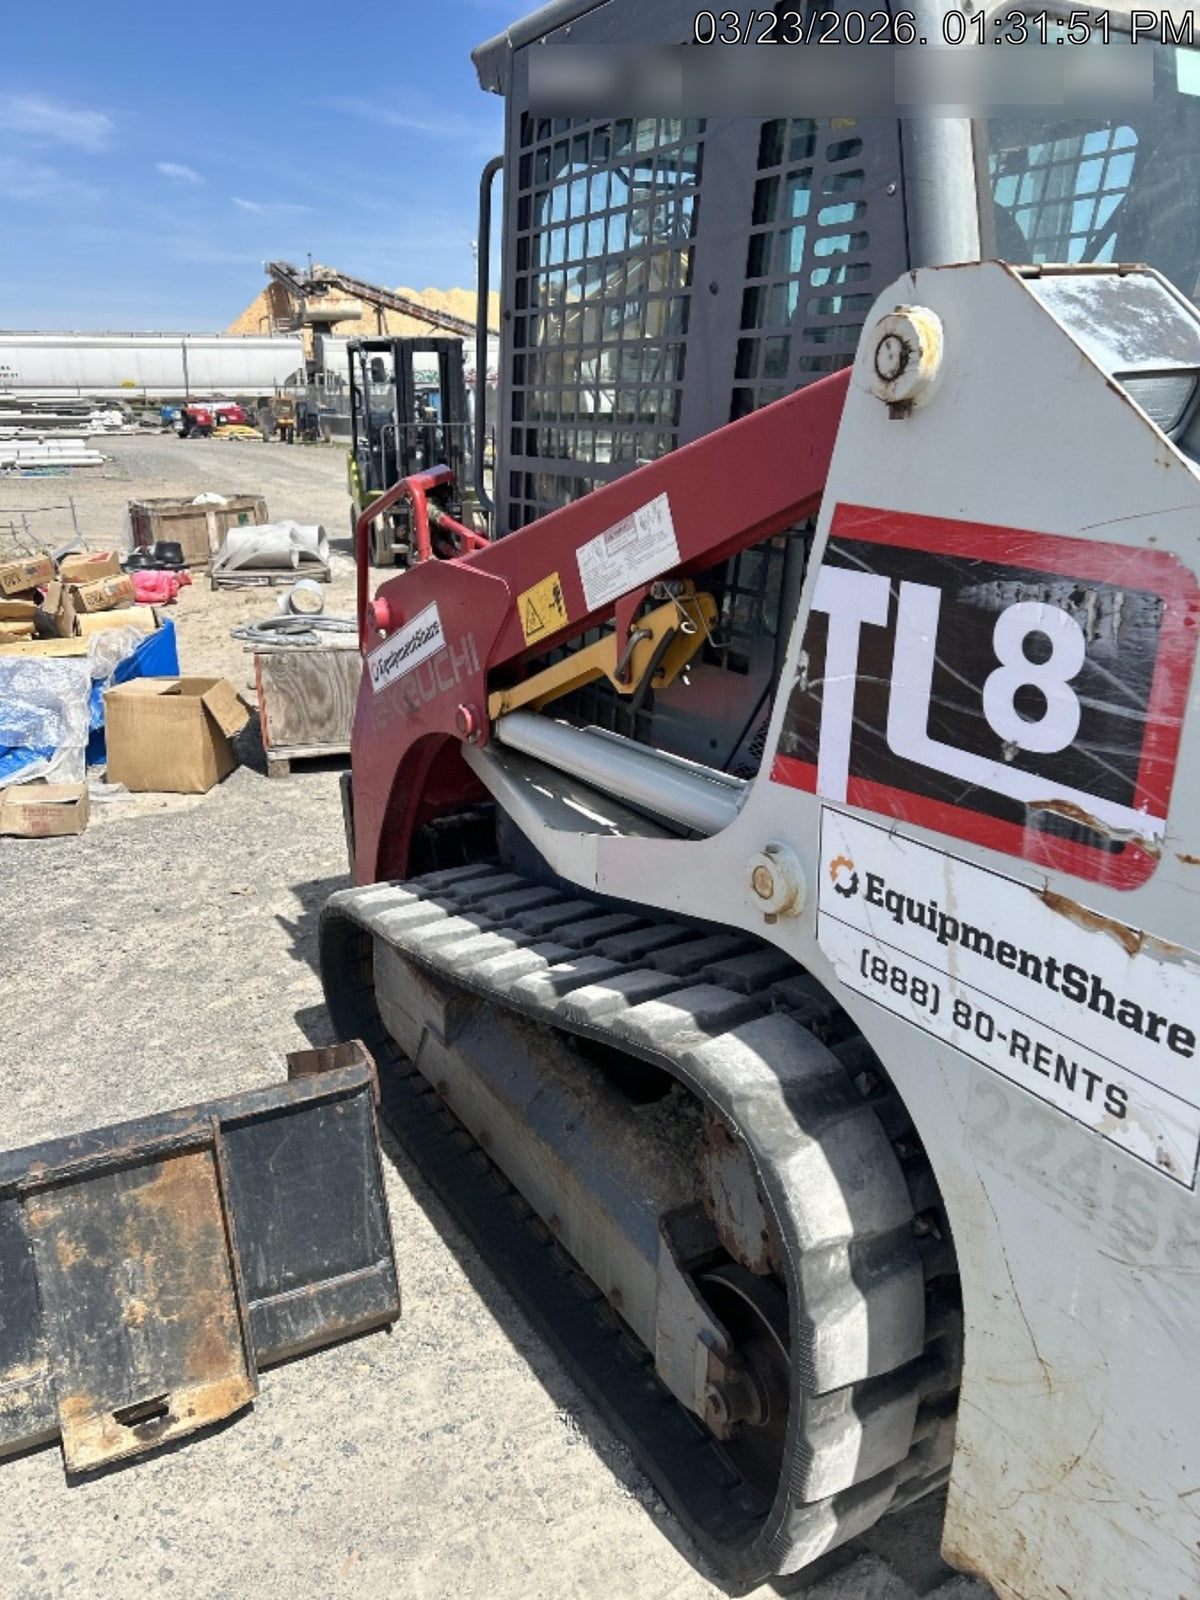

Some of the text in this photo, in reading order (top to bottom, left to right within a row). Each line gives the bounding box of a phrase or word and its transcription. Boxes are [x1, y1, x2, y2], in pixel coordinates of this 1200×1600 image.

[810, 565, 1167, 839] TL8
[860, 949, 1129, 1120] (888) 80-RENTS
[864, 871, 1197, 1060] EquipmentShare
